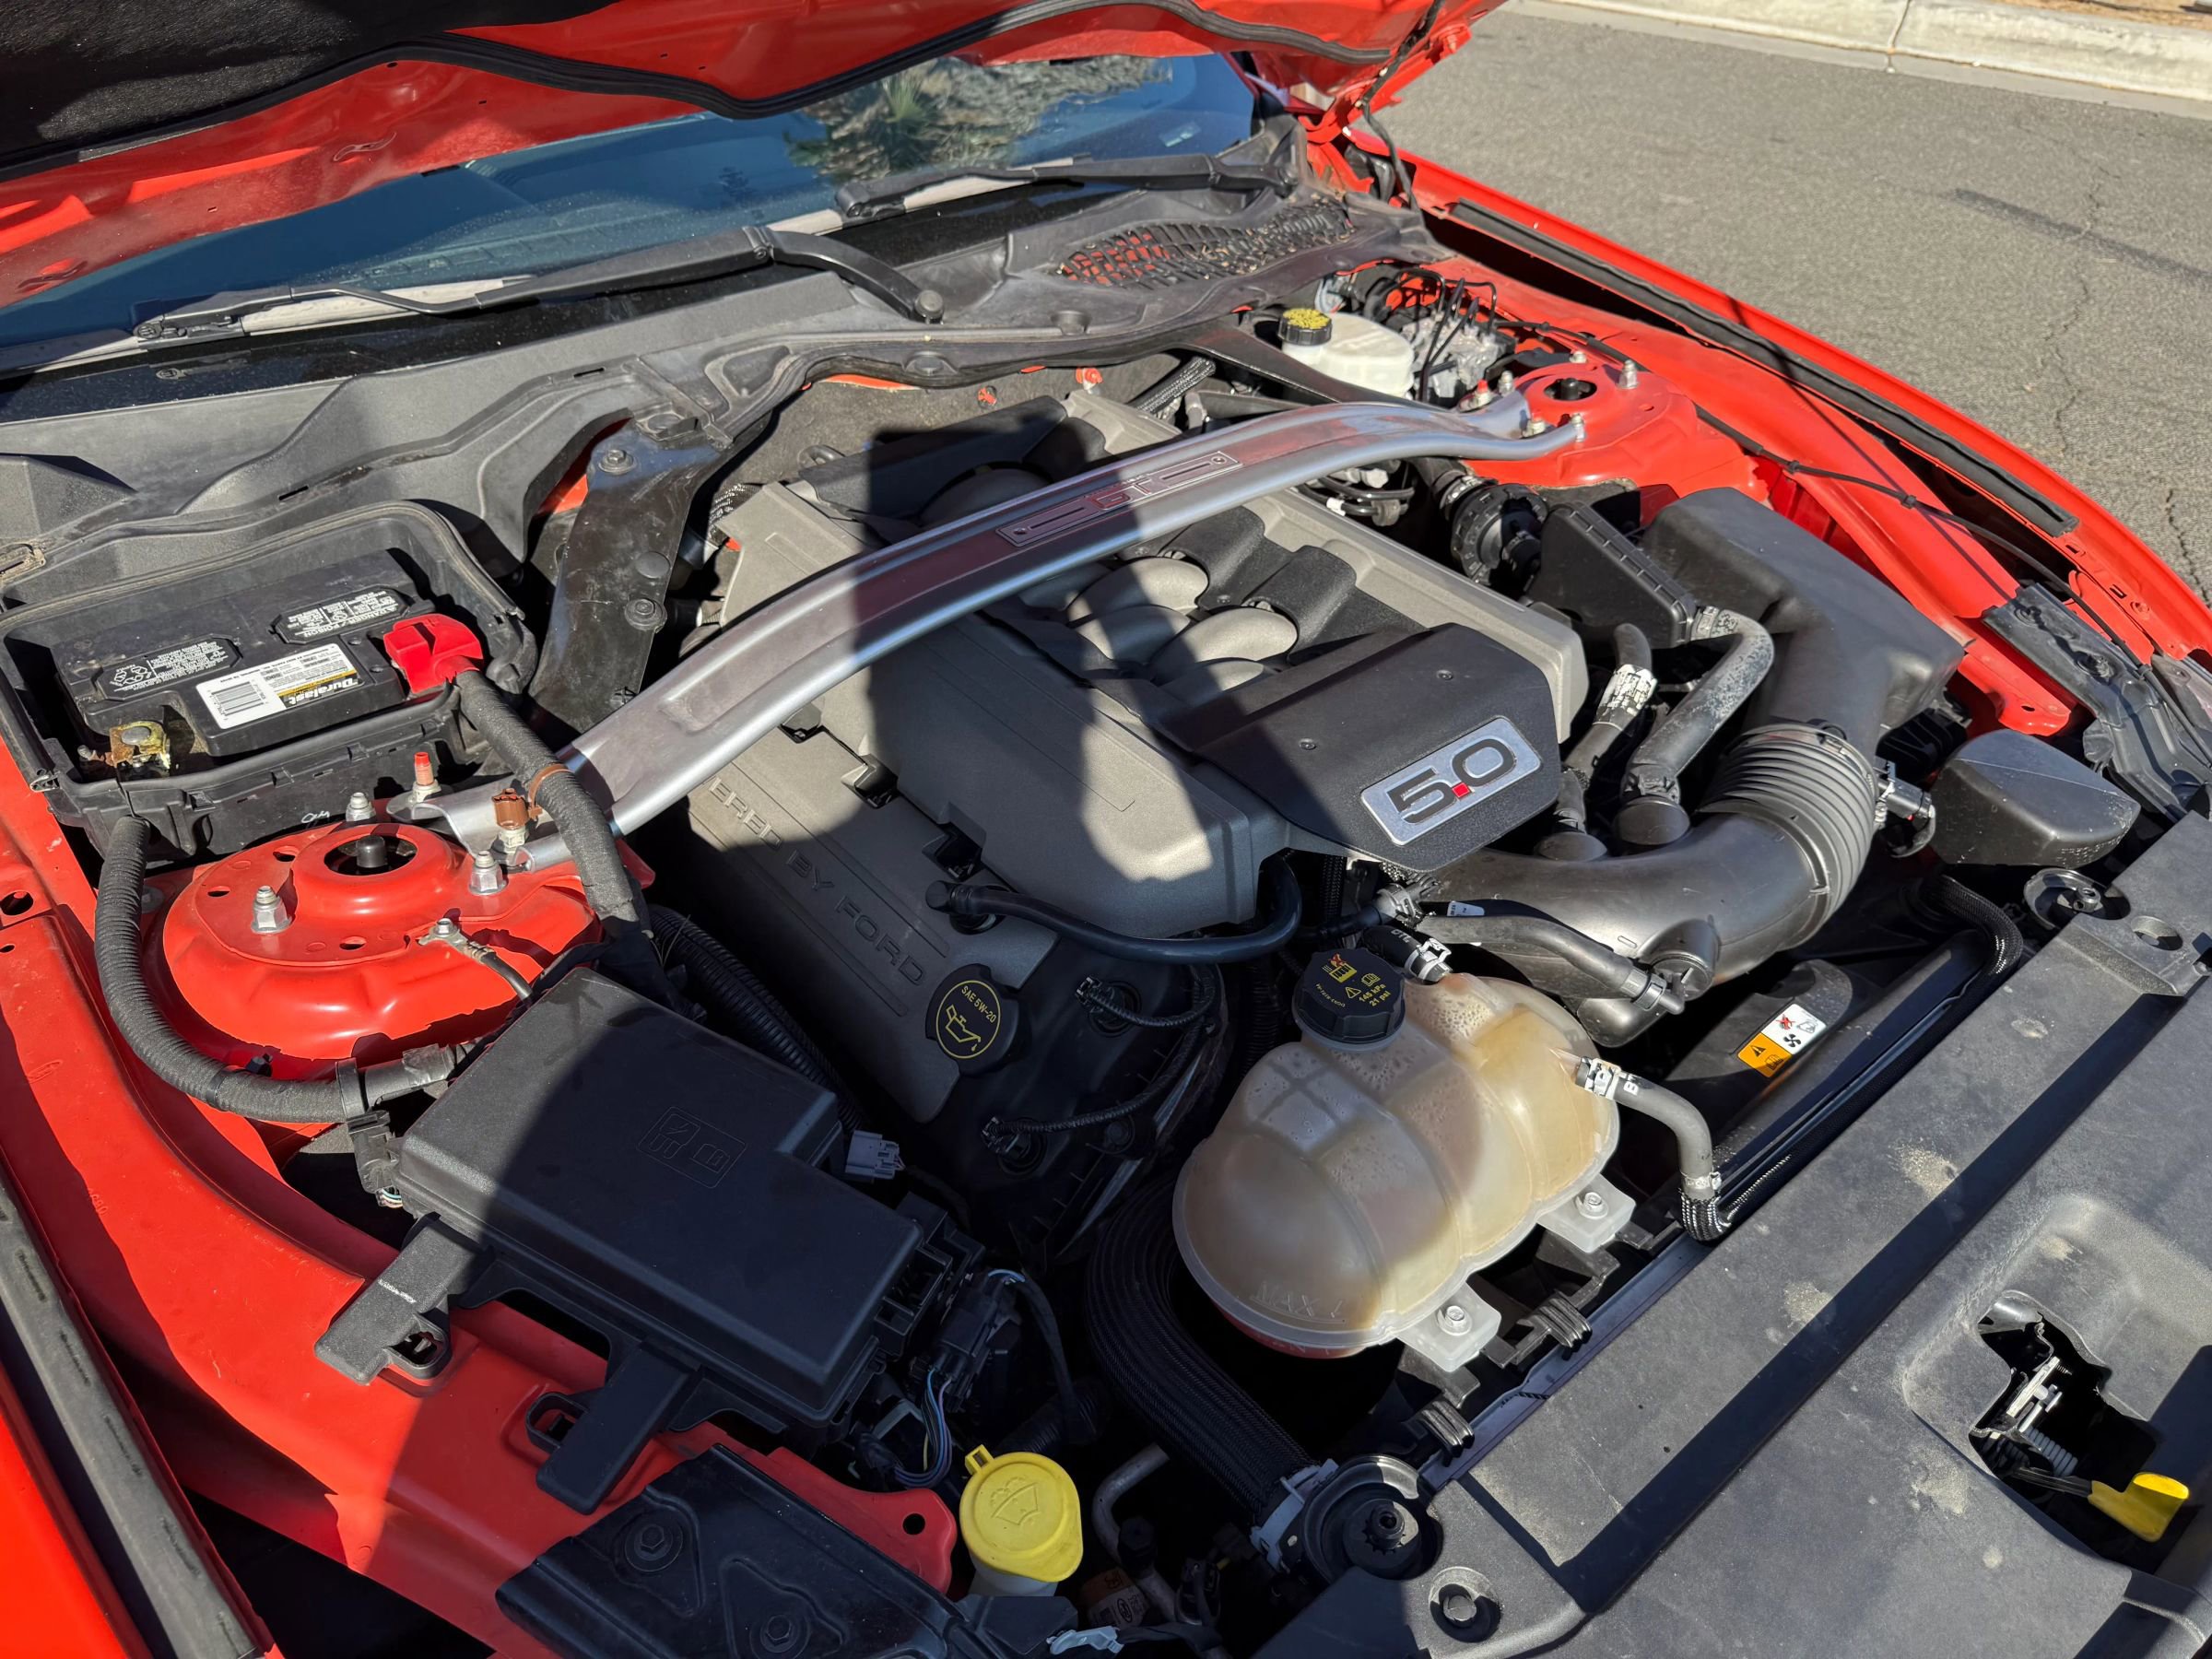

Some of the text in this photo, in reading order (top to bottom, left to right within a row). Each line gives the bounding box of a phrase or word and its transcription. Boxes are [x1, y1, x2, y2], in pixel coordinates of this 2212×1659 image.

[288, 677, 359, 705] Duralast
[1386, 737, 1516, 824] 5.0
[707, 776, 925, 987] ERED BY FORD
[961, 985, 997, 1023] SAE 5W-20
[1359, 991, 1373, 1003] 145
[1371, 983, 1386, 994] kPa
[1370, 990, 1392, 1007] 21 psi
